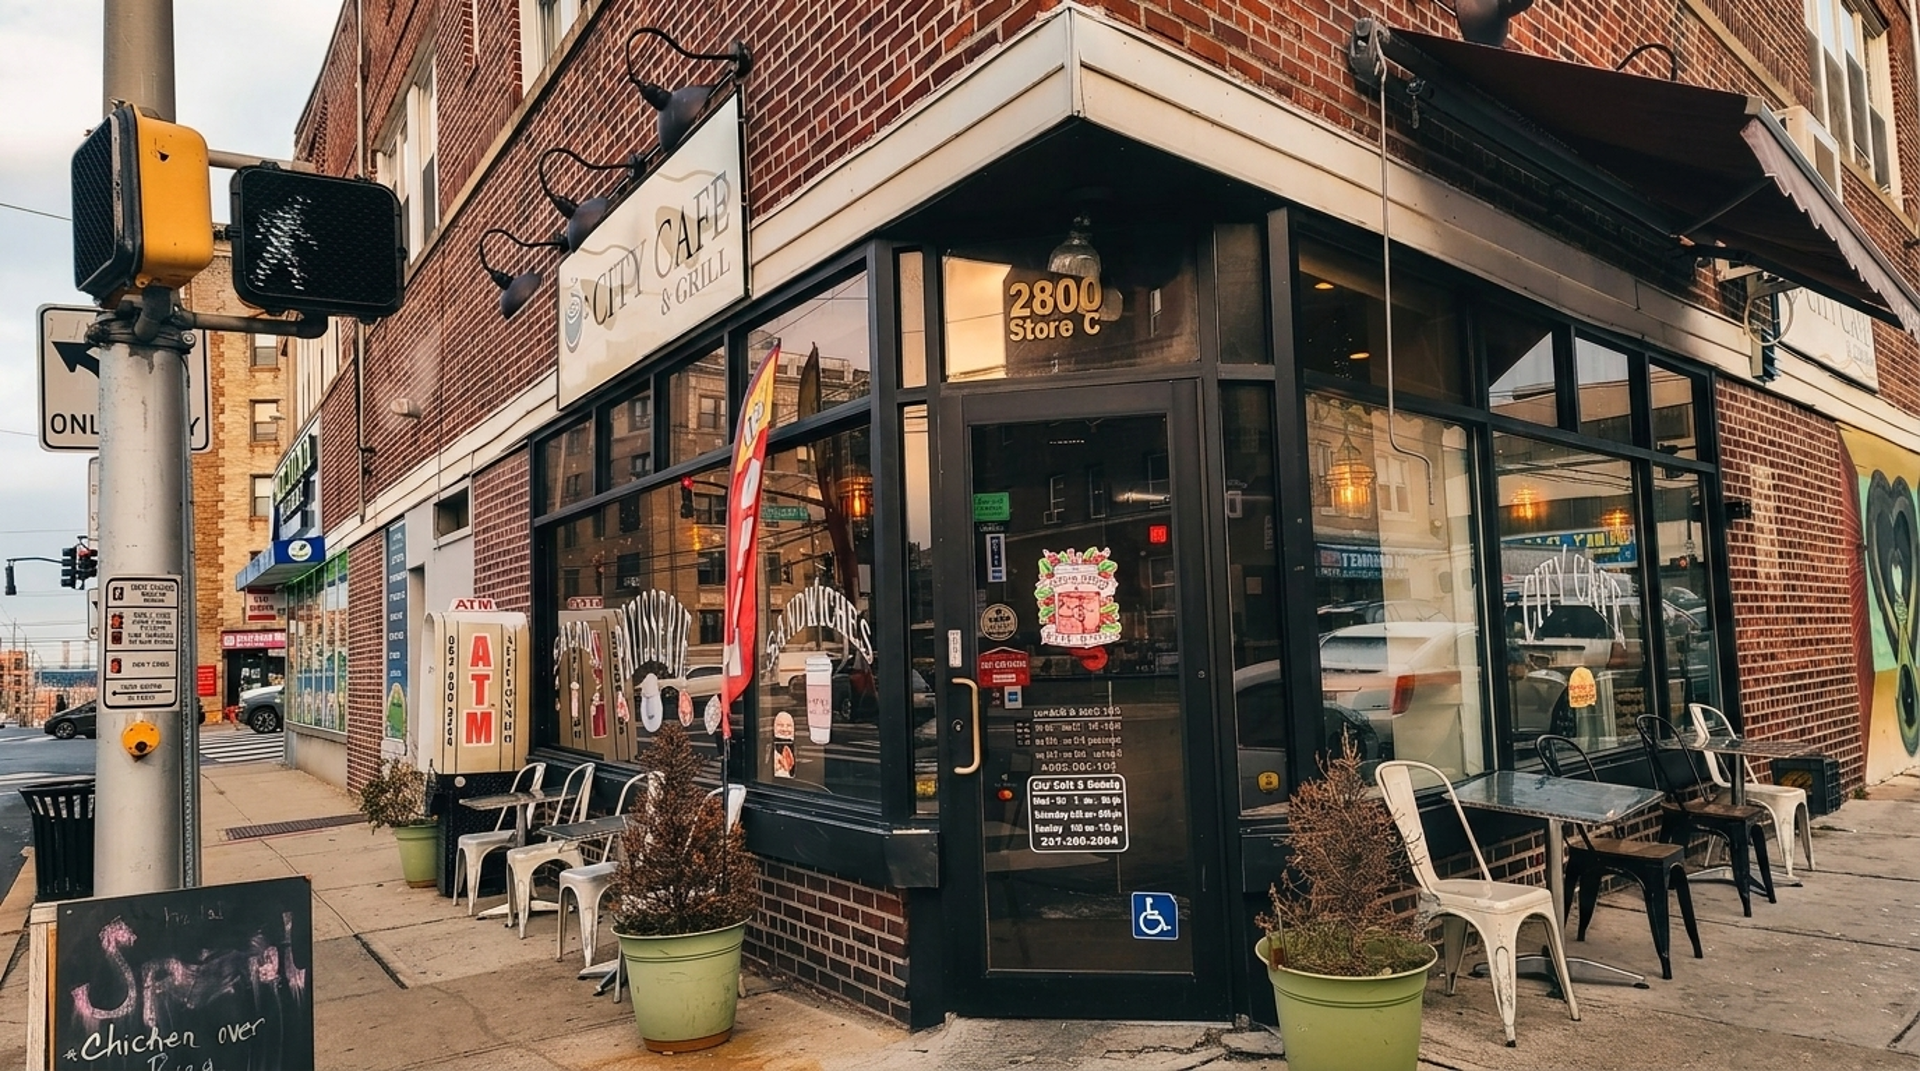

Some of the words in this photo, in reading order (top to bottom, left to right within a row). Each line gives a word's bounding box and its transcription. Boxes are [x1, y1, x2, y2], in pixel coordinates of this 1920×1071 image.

[592, 239, 647, 326] CITY
[675, 247, 731, 305] GRILL
[1009, 276, 1102, 319] 2800
[1009, 318, 1074, 341] Store
[1083, 311, 1100, 335] C
[51, 413, 99, 435] ONL
[455, 599, 494, 610] ATM
[465, 635, 492, 744] ATM
[217, 1017, 266, 1045] over
